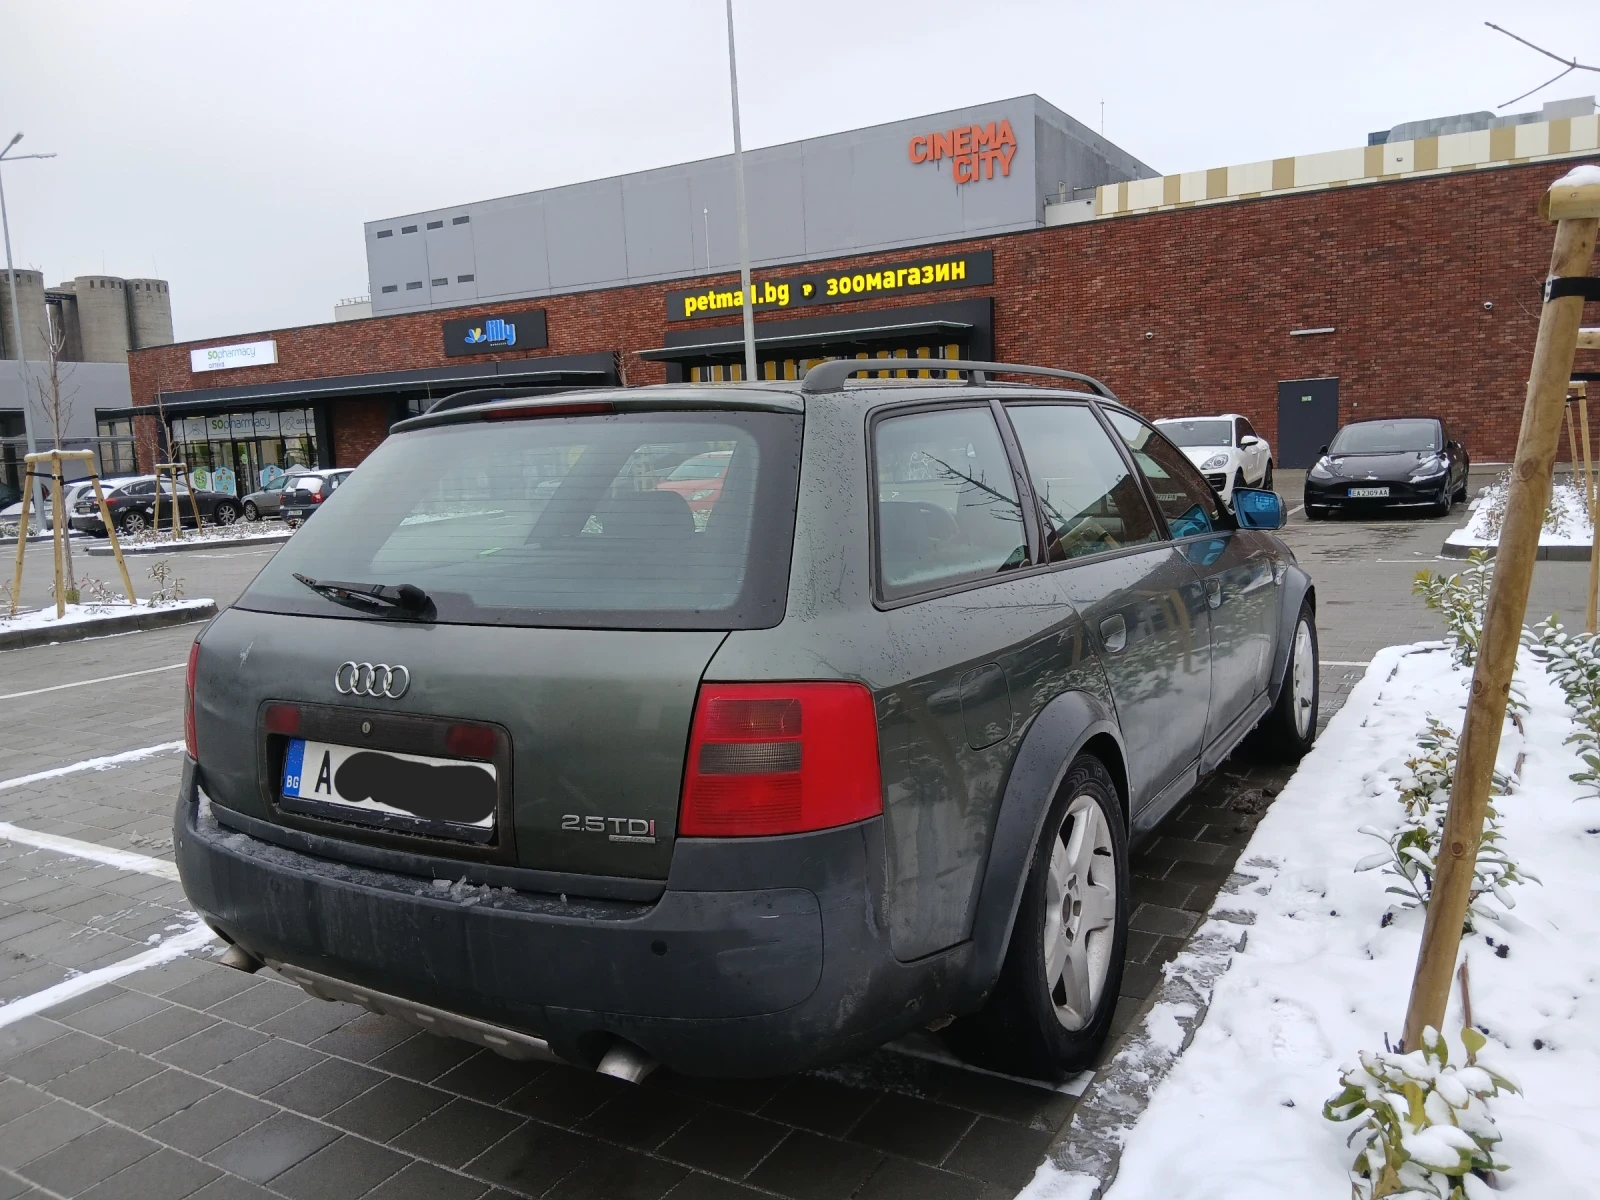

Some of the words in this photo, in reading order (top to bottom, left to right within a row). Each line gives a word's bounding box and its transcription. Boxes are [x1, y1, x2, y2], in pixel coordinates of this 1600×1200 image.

[908, 117, 1017, 165] CINEMA
[952, 146, 1017, 184] CITY
[684, 281, 789, 317] petmal.bg
[826, 260, 966, 296] зоомагазин
[485, 319, 516, 345] lilly
[286, 775, 299, 789] BG
[314, 750, 332, 795] A
